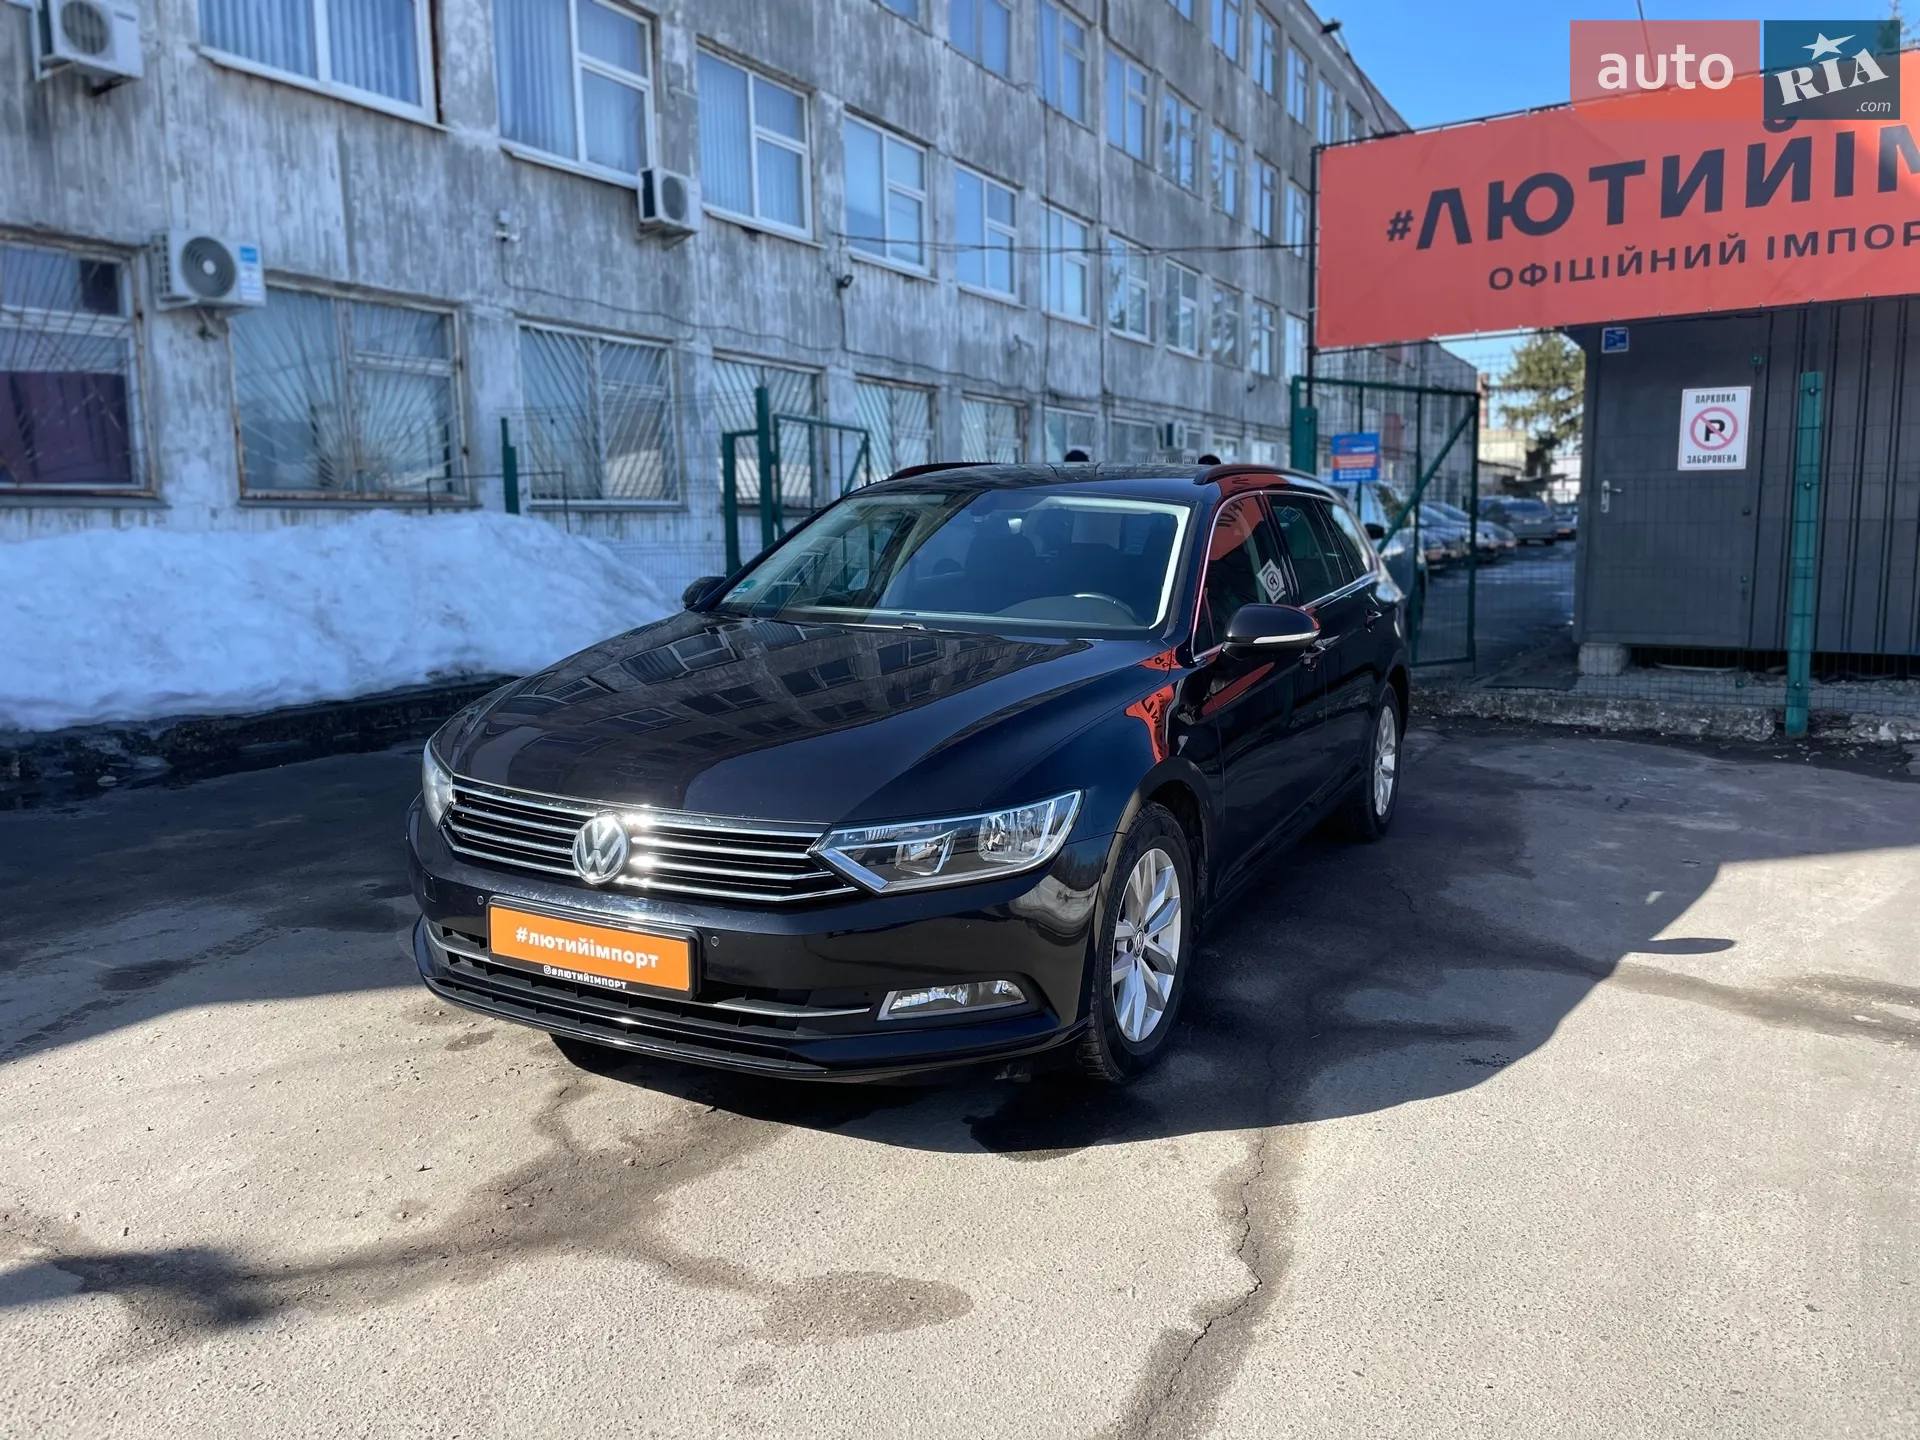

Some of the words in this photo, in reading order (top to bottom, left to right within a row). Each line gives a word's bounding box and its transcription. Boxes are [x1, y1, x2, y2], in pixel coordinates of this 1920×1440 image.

[1488, 232, 1747, 291] ОФІЦІЙНИЙ
[1695, 393, 1737, 404] ПАРКОВКА
[1686, 454, 1737, 464] ЗАБОРОНЕНА
[515, 926, 659, 969] #лютийімпорт
